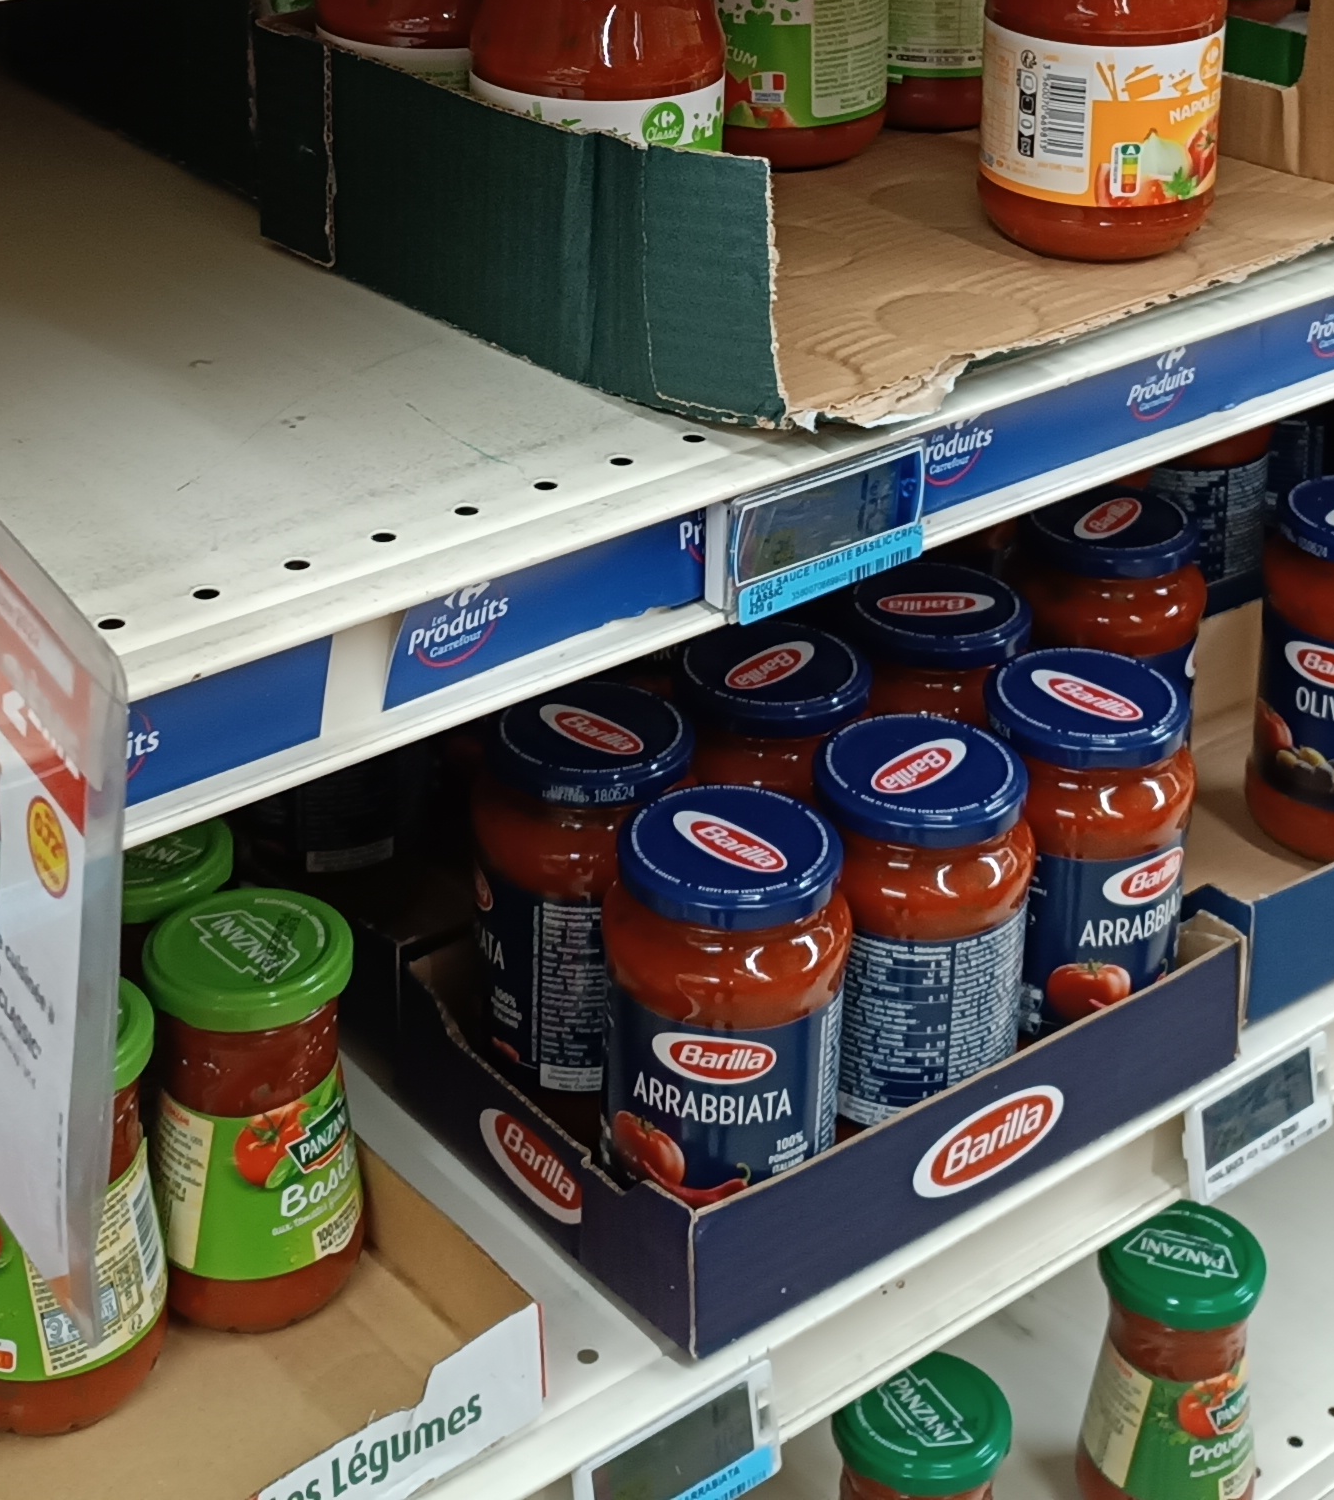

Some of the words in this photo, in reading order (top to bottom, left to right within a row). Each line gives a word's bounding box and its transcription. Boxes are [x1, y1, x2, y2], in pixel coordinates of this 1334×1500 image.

[1127, 366, 1195, 407] Produits
[925, 426, 994, 464] roduits
[929, 455, 971, 475] Carrefour
[776, 567, 811, 588] SAUCE
[813, 553, 853, 577] TOMATE
[854, 537, 893, 563] BASILIC
[408, 593, 509, 656] Produits
[431, 610, 448, 627] Les
[429, 627, 483, 658] Carrefour
[1055, 680, 1135, 718] Barilla
[566, 713, 633, 754] Barilla
[878, 745, 949, 796] Barilla
[696, 823, 776, 868] Barilla
[678, 1043, 766, 1071] Barilla
[633, 1071, 794, 1126] ARRABBIATA
[775, 1133, 805, 1151] 100%
[942, 1100, 1048, 1180] Barilla
[502, 1120, 577, 1203] Barilla
[1140, 1236, 1226, 1271] PANZANI
[887, 1376, 957, 1443] PANZANI
[332, 1392, 485, 1487] Légumes
